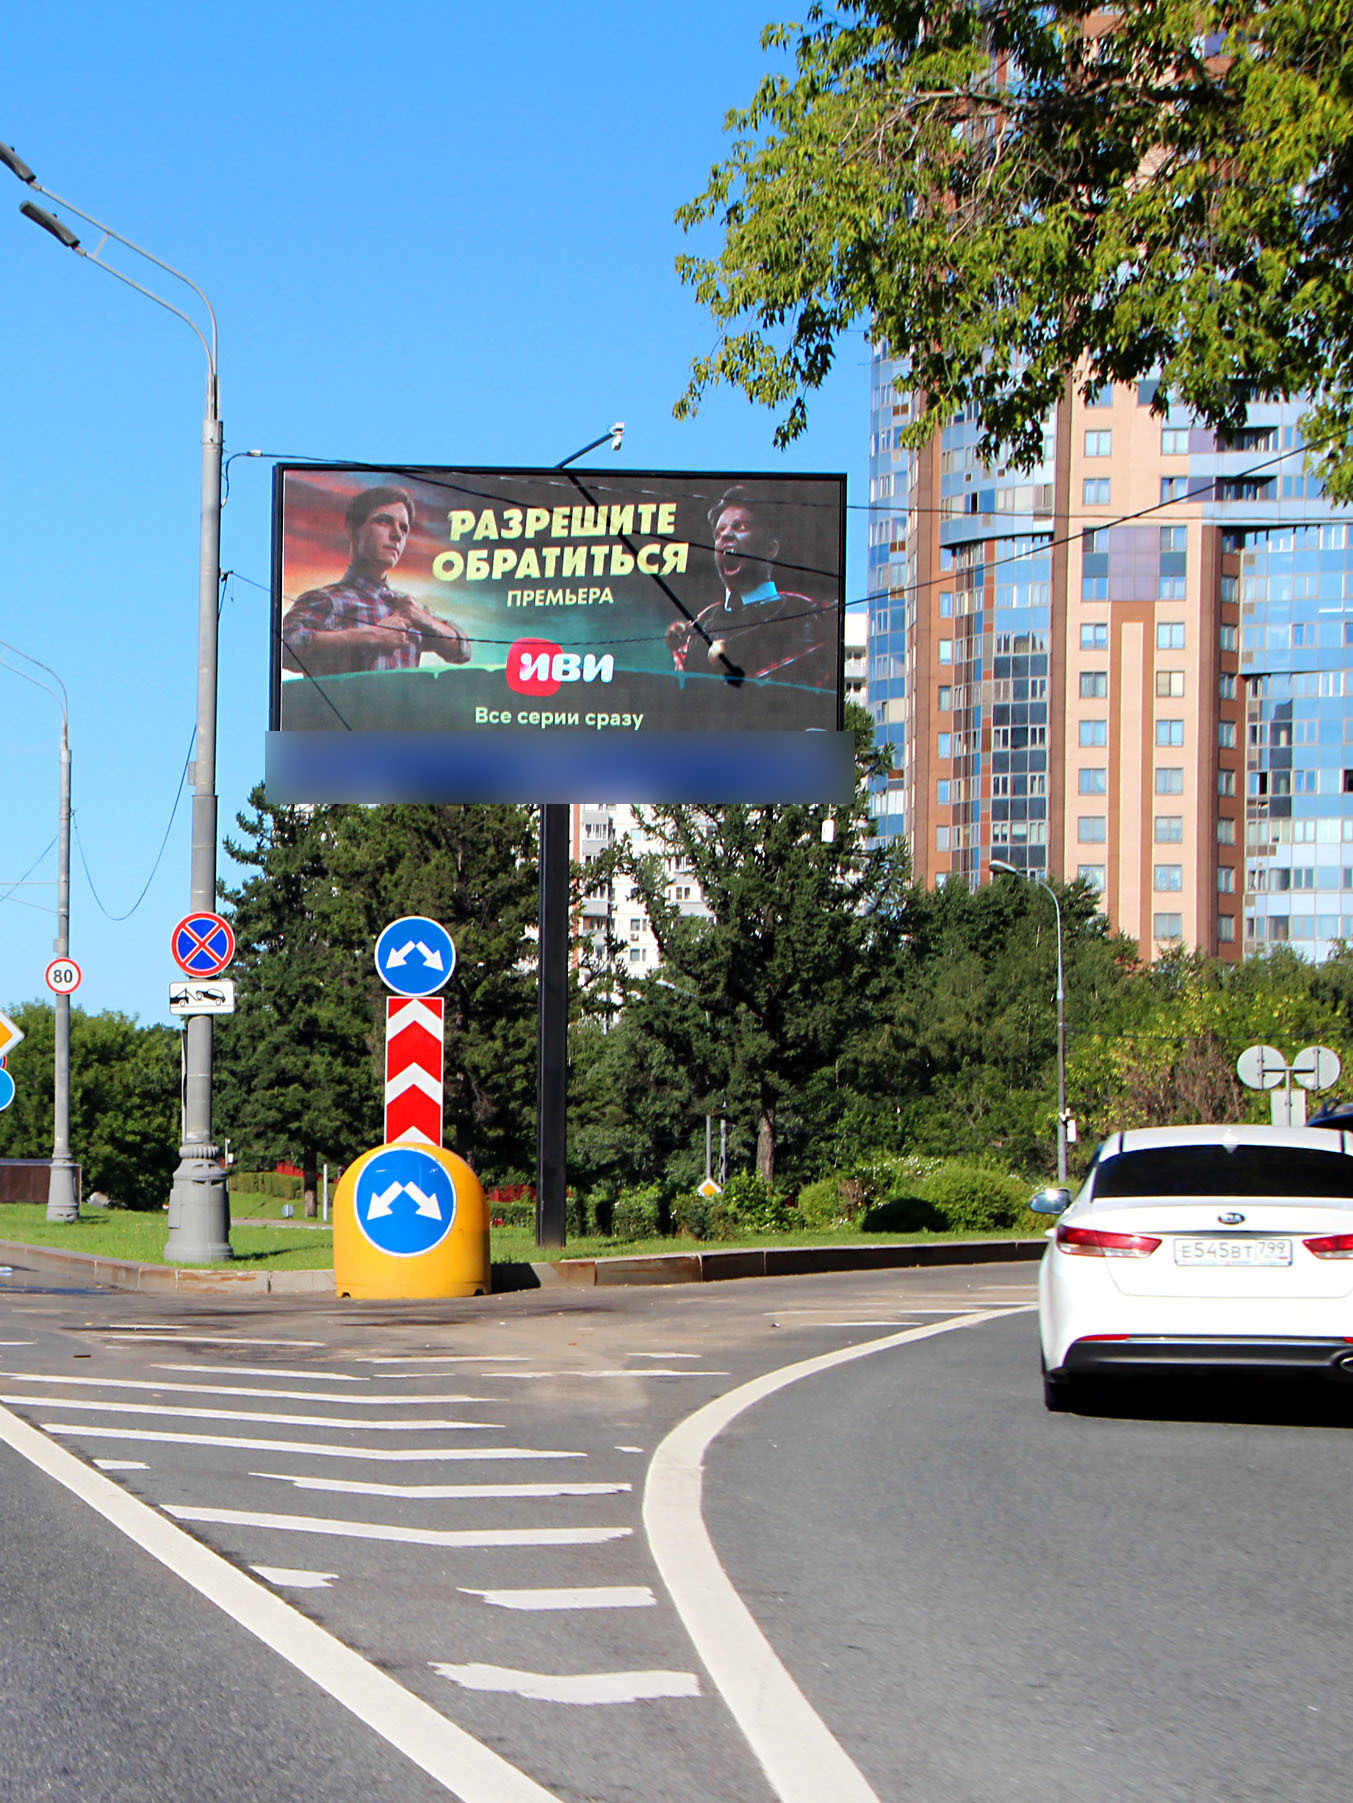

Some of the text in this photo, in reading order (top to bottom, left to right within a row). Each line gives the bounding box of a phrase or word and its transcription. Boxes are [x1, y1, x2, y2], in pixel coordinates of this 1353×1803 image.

[448, 502, 677, 541] РАЗРЕШИТЕ
[432, 542, 690, 582] ОБРАТИТЬСЯ
[506, 587, 614, 607] ПРЕМЬЕРА
[475, 706, 644, 731] Все серии сразу
[53, 969, 73, 983] 80
